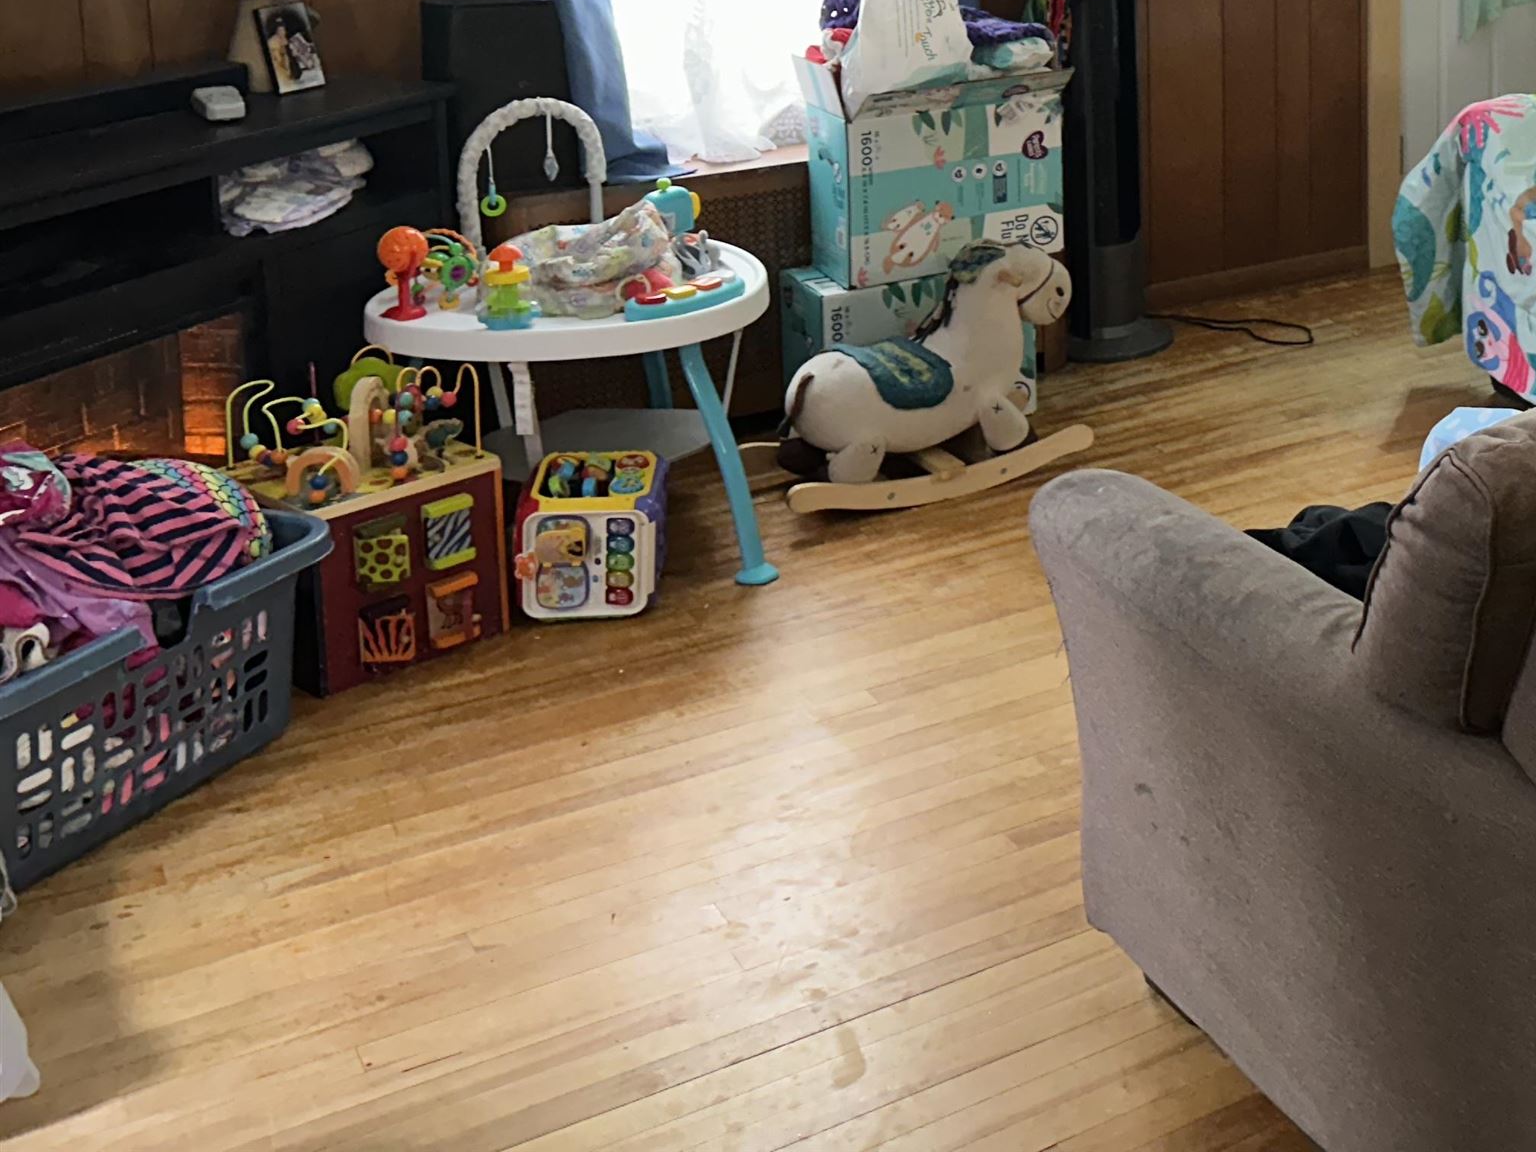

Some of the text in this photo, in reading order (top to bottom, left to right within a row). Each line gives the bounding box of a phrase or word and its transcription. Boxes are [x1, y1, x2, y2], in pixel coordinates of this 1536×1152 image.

[861, 130, 873, 166] 1600
[1000, 220, 1015, 240] Flu
[1015, 214, 1029, 231] Do
[831, 306, 844, 342] 1600
